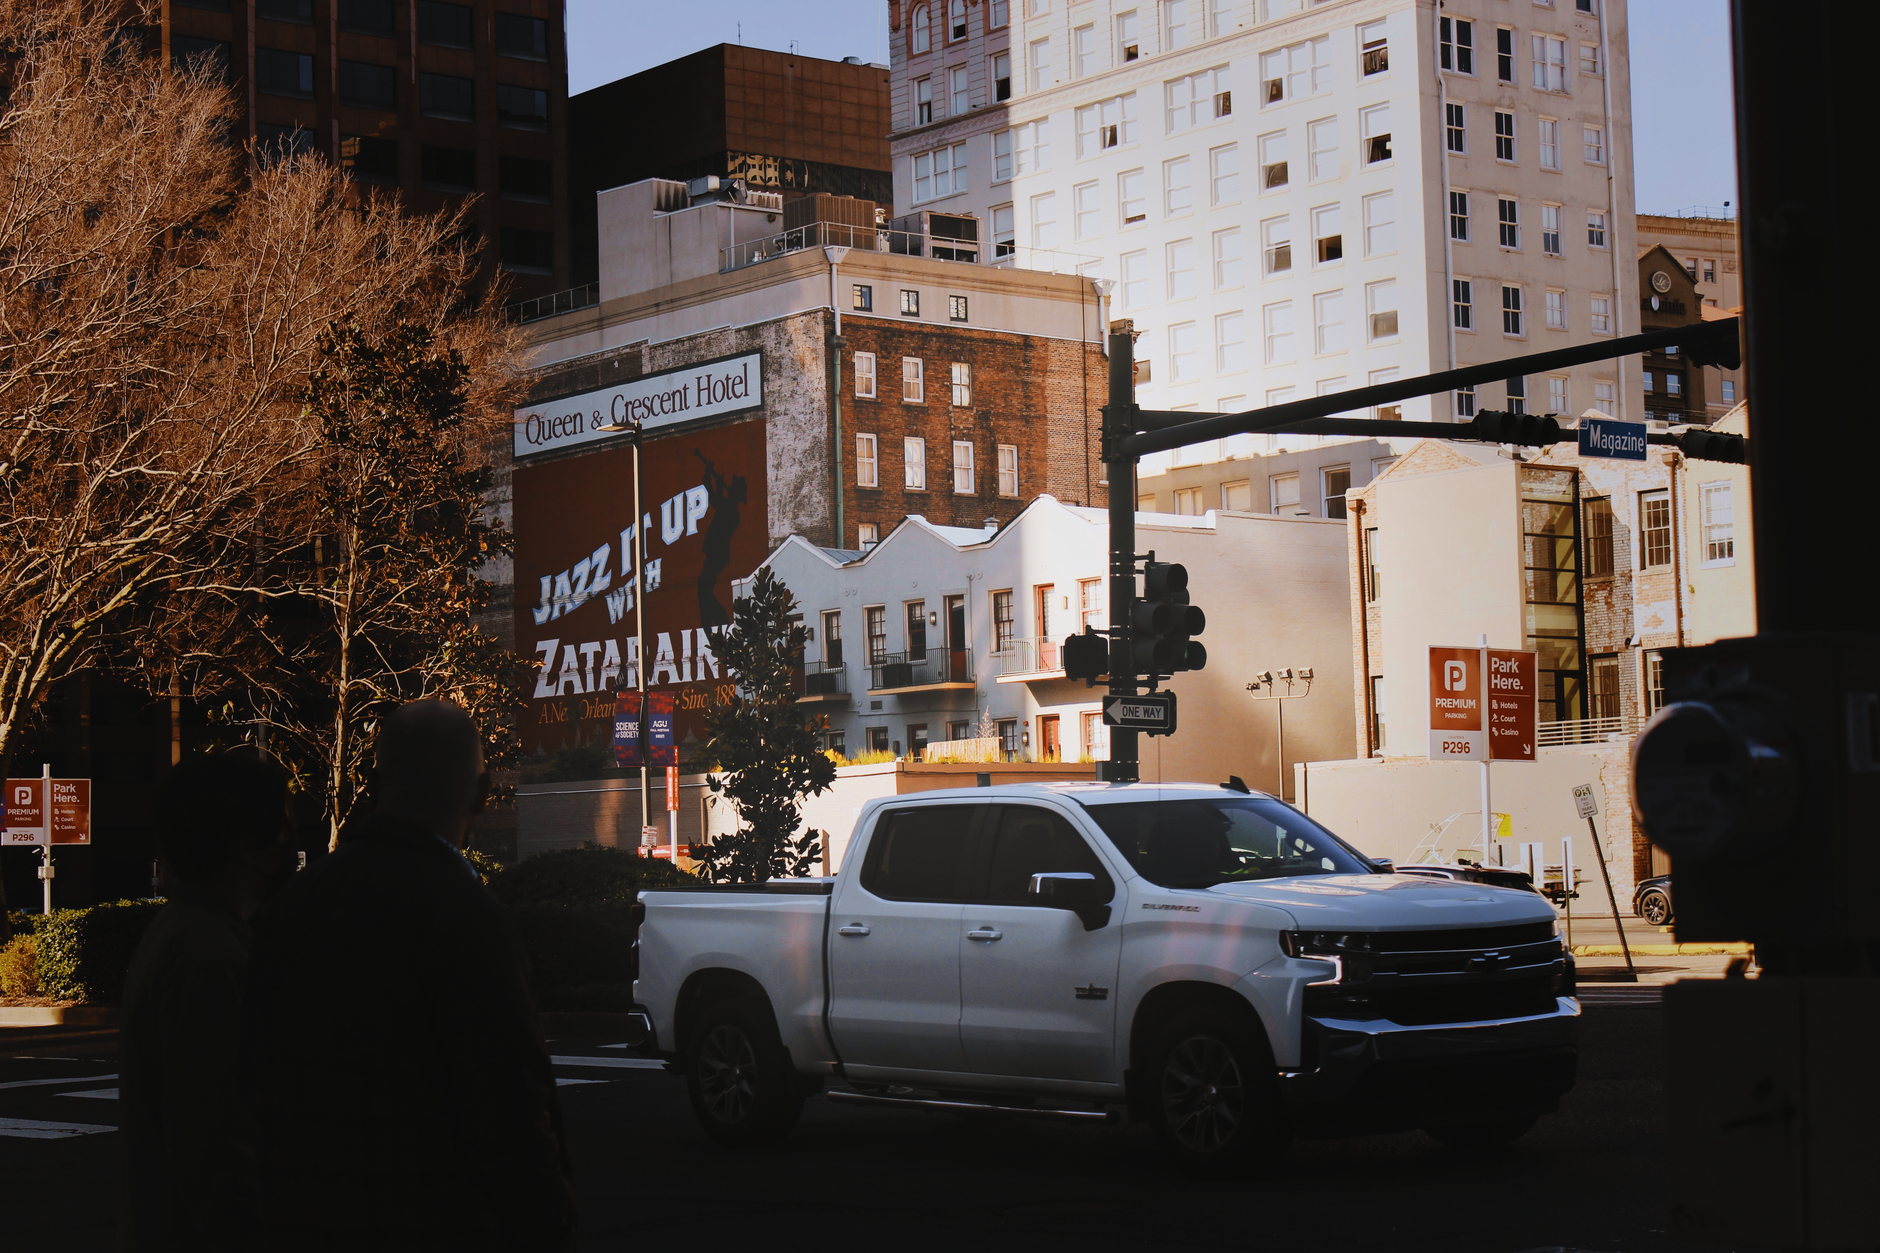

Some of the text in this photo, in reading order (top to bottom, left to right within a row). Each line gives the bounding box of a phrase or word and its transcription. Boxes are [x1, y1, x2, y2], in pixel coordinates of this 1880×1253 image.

[525, 362, 750, 446] Queen & Crescent Hotel
[1589, 424, 1645, 455] Magazine
[532, 542, 612, 625] JAZZ
[660, 484, 710, 545] UP
[604, 557, 663, 625] WIH
[1491, 657, 1519, 674] Park
[1491, 674, 1524, 690] Here.
[538, 684, 736, 724] A Ne Orlean Sinc 188
[1435, 697, 1476, 709] PREMIUM
[1500, 701, 1518, 710] Hotels
[1122, 705, 1162, 719] ONE WAY
[1444, 712, 1467, 720] PARKING
[652, 720, 668, 728] AGU
[1500, 715, 1516, 723] Court
[615, 721, 640, 732] SCIENCE
[1500, 728, 1519, 736] Casino
[620, 730, 640, 739] SOCIETY
[1442, 741, 1471, 755] P296
[53, 783, 76, 793] Park
[53, 793, 80, 803] Here.
[7, 808, 40, 816] PREMIUM
[12, 833, 35, 842] P296
